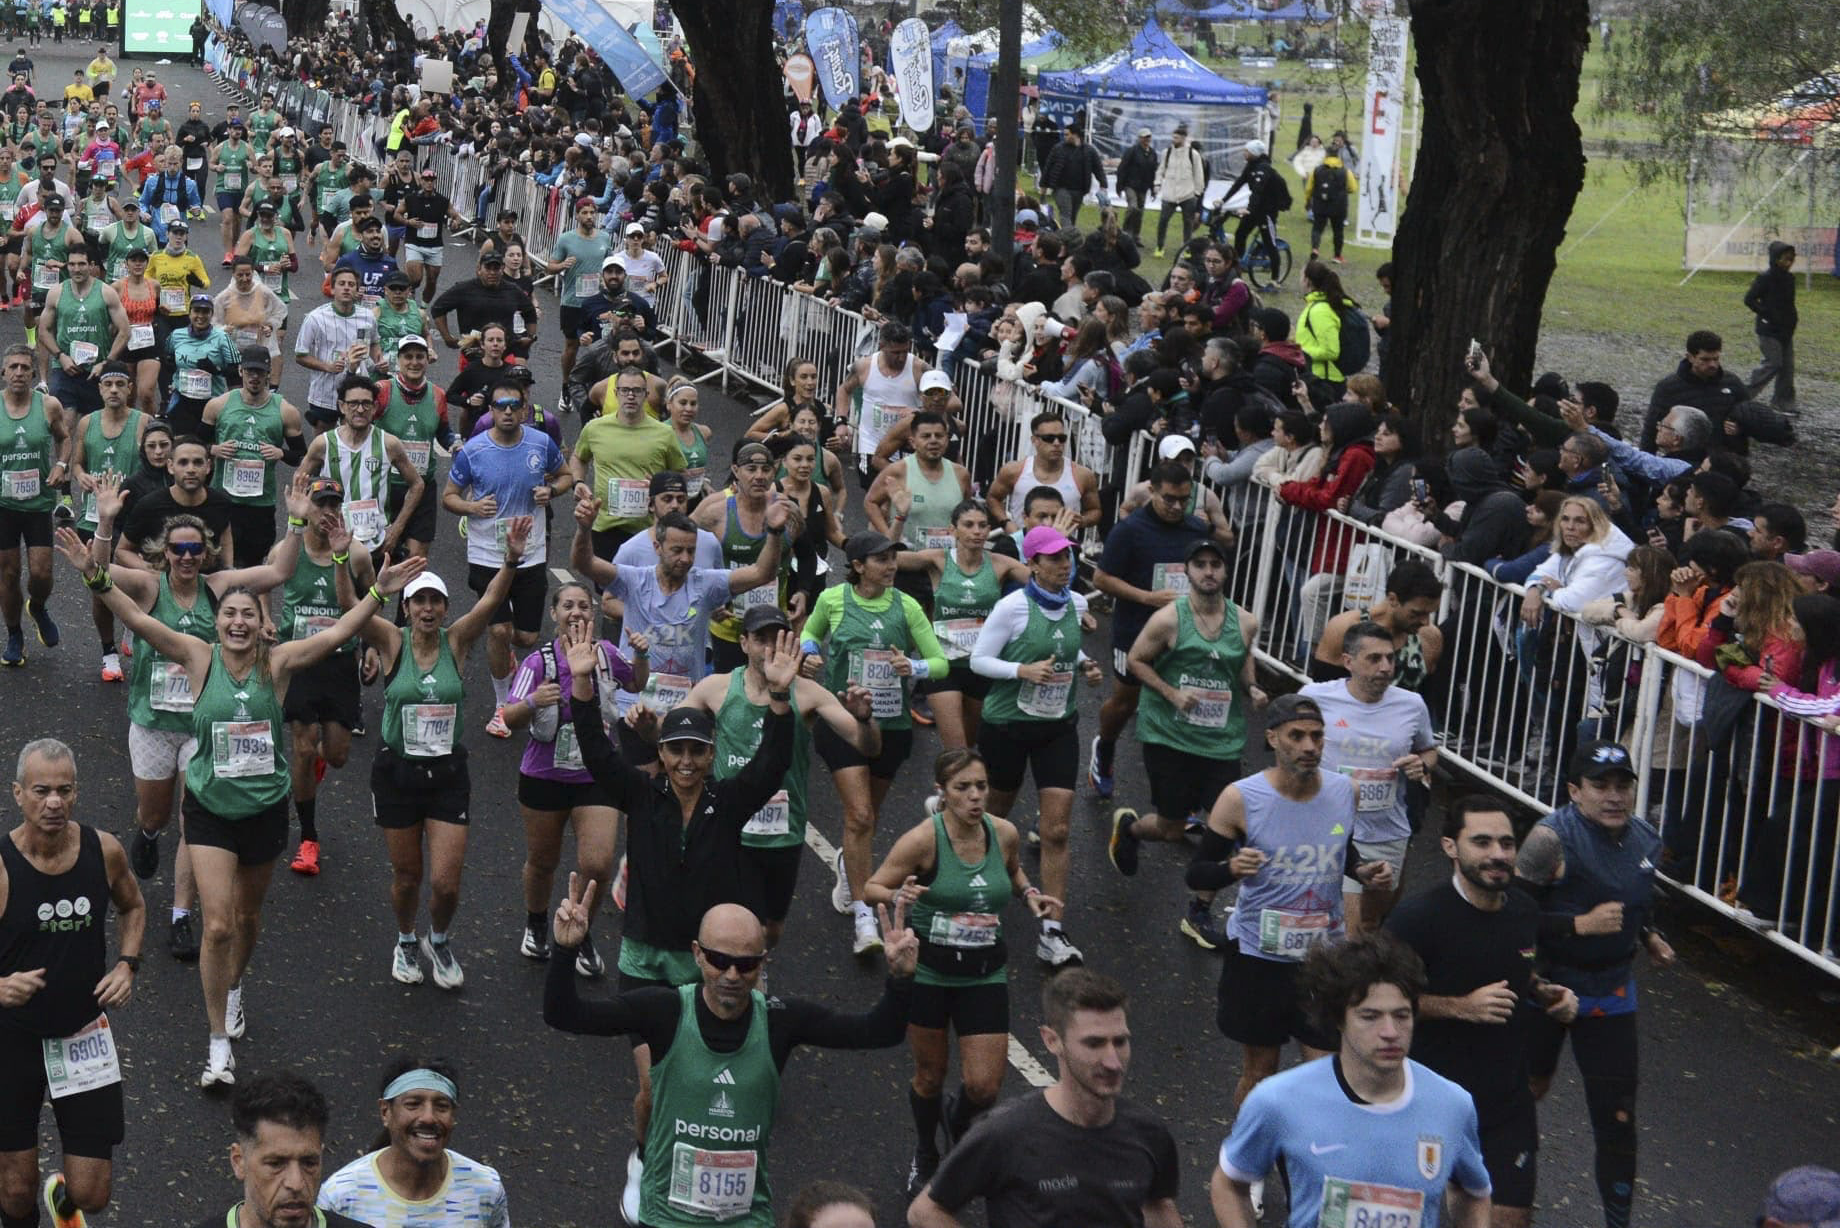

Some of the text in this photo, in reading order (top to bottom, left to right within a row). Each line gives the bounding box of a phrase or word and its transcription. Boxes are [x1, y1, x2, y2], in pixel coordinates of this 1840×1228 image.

[67, 323, 98, 335] personal
[2, 449, 40, 462] personal
[1338, 736, 1393, 757] 42K
[1271, 843, 1342, 876] 42K
[38, 914, 93, 933] start
[67, 1032, 112, 1065] 6905
[673, 1117, 761, 1144] personal
[699, 1171, 749, 1198] 8155
[1037, 1174, 1080, 1193] made
